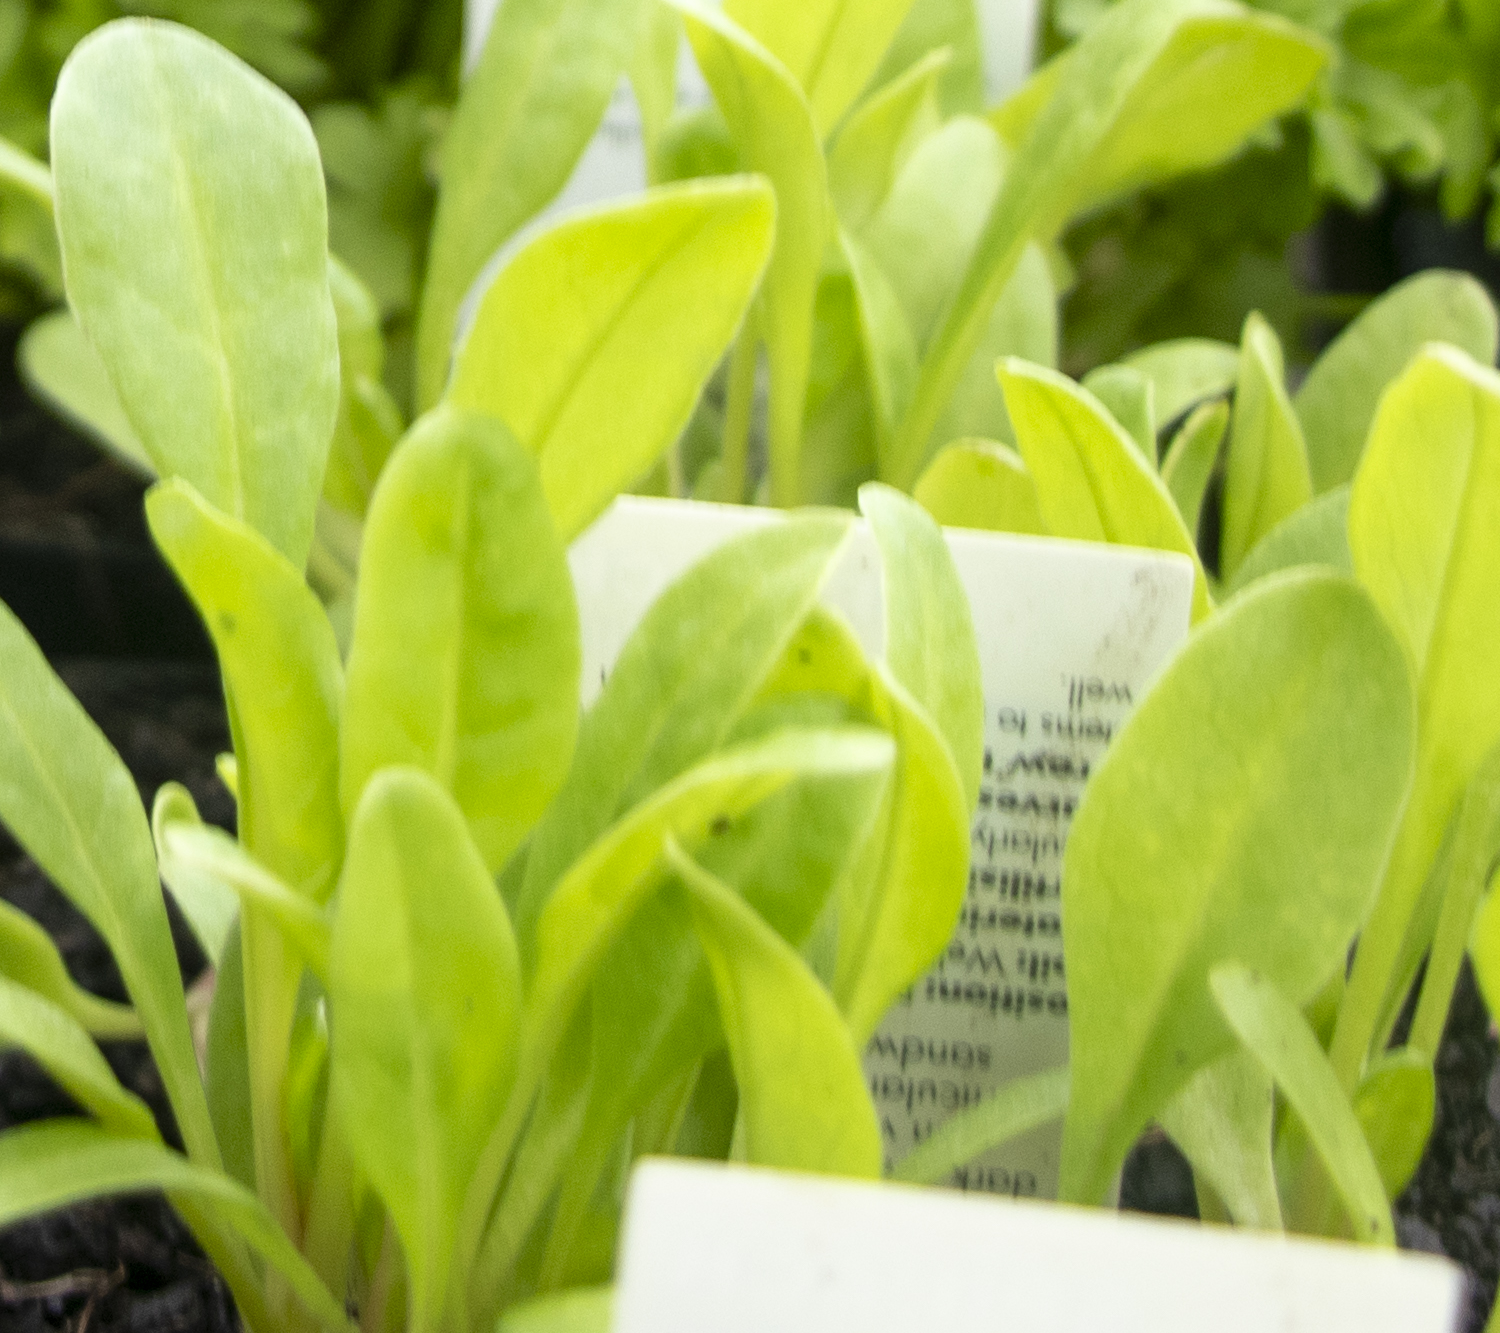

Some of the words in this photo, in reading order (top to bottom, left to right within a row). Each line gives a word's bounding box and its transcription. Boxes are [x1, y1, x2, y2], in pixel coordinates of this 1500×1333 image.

[974, 821, 1061, 866] ularly
[926, 977, 1068, 1022] osition:
[867, 1035, 992, 1072] sandw
